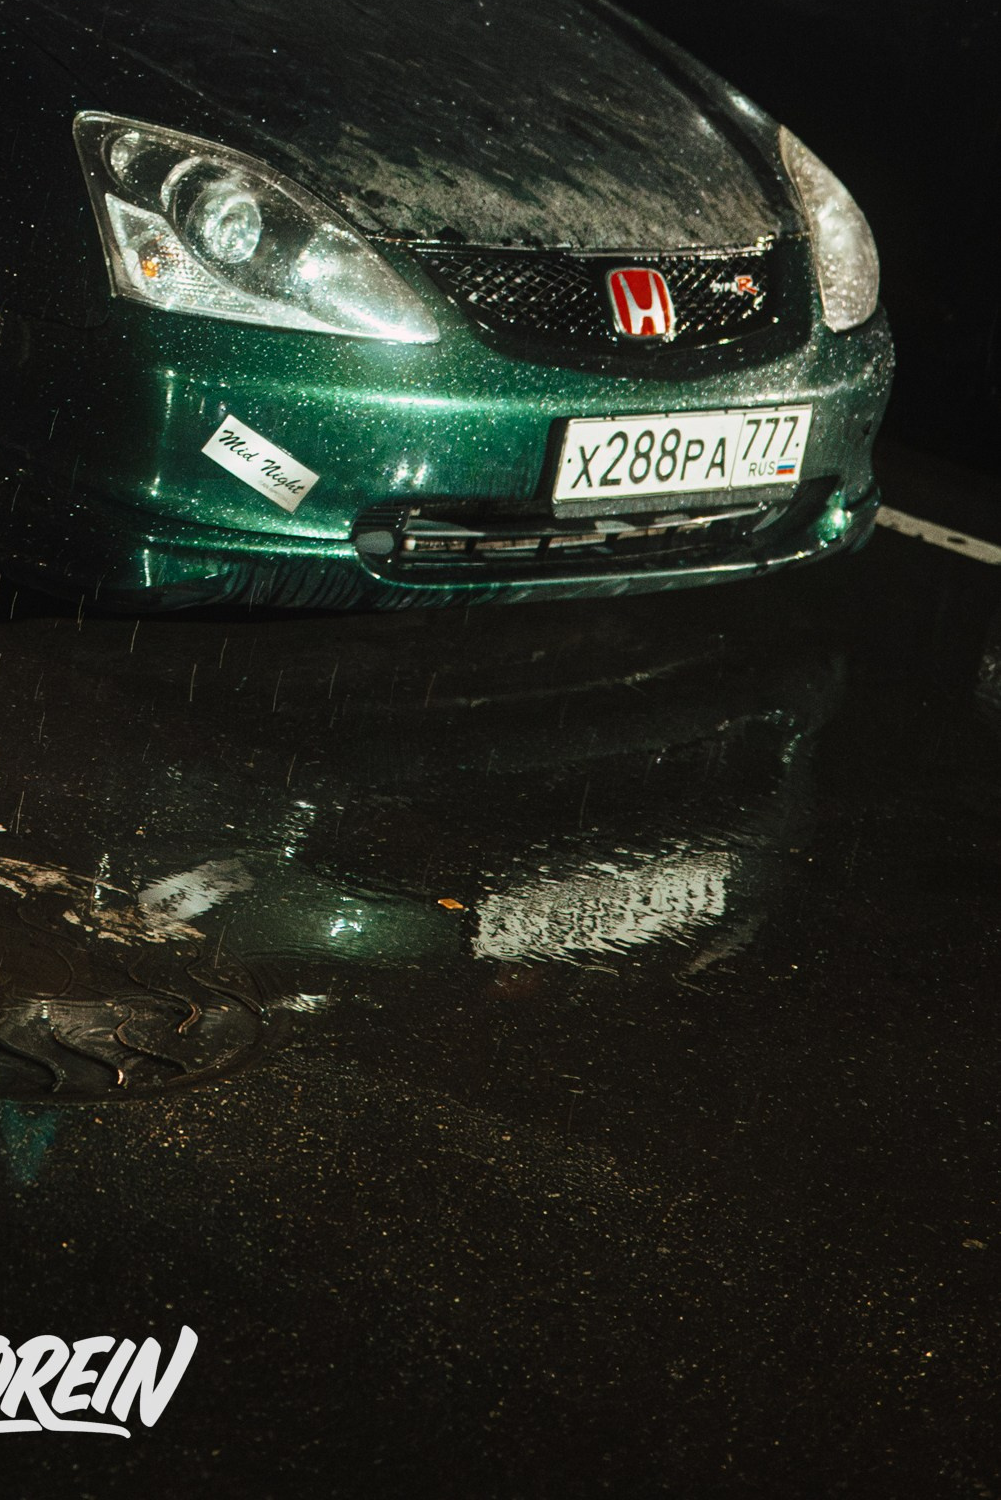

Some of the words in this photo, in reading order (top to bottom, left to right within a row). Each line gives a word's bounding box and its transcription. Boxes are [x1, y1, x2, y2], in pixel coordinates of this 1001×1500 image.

[219, 429, 259, 462] Mid
[261, 459, 305, 494] Night
[571, 428, 726, 489] Х288РА
[742, 416, 799, 460] 777
[749, 461, 776, 477] RUS
